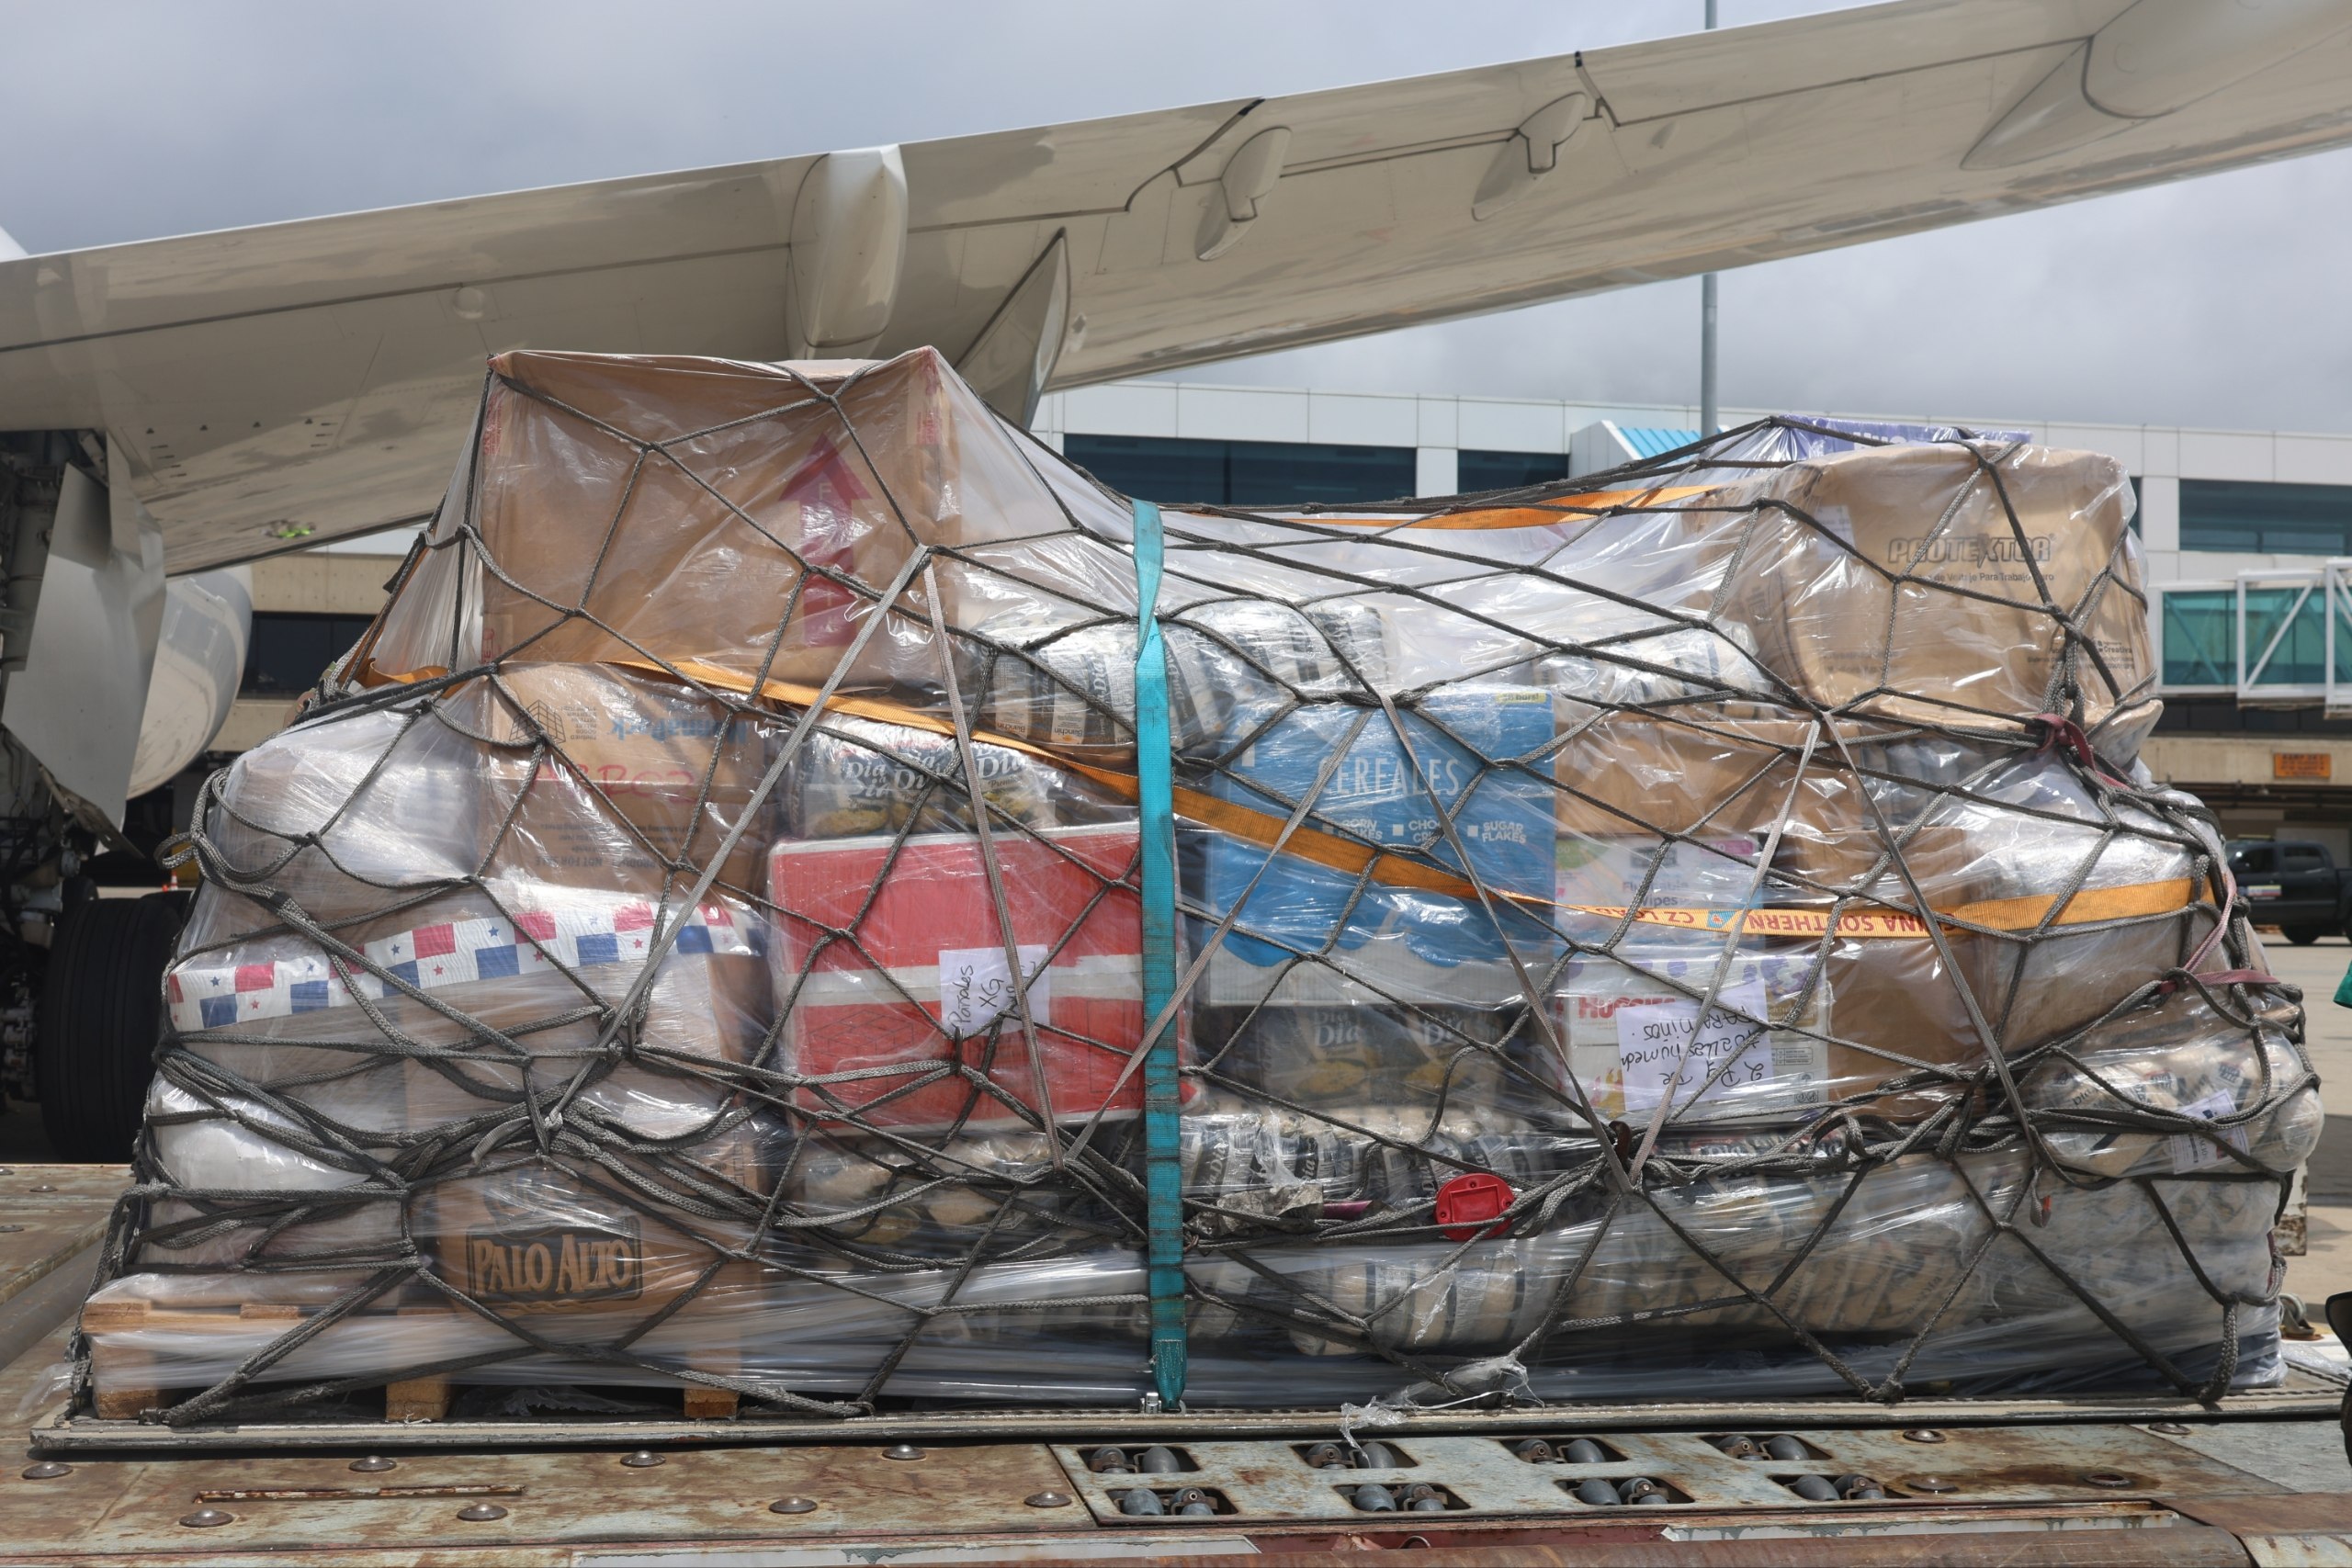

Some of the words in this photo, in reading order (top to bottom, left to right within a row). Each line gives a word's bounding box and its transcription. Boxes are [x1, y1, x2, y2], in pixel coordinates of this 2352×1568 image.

[1054, 727, 1083, 737] Bianchin
[1482, 821, 1523, 833] SUGAR
[1481, 832, 1527, 844] FLAKES
[1663, 911, 1696, 924] CZ
[1744, 1060, 1764, 1081] 2
[472, 1238, 553, 1297] PALO
[555, 1234, 634, 1294] ALTO
